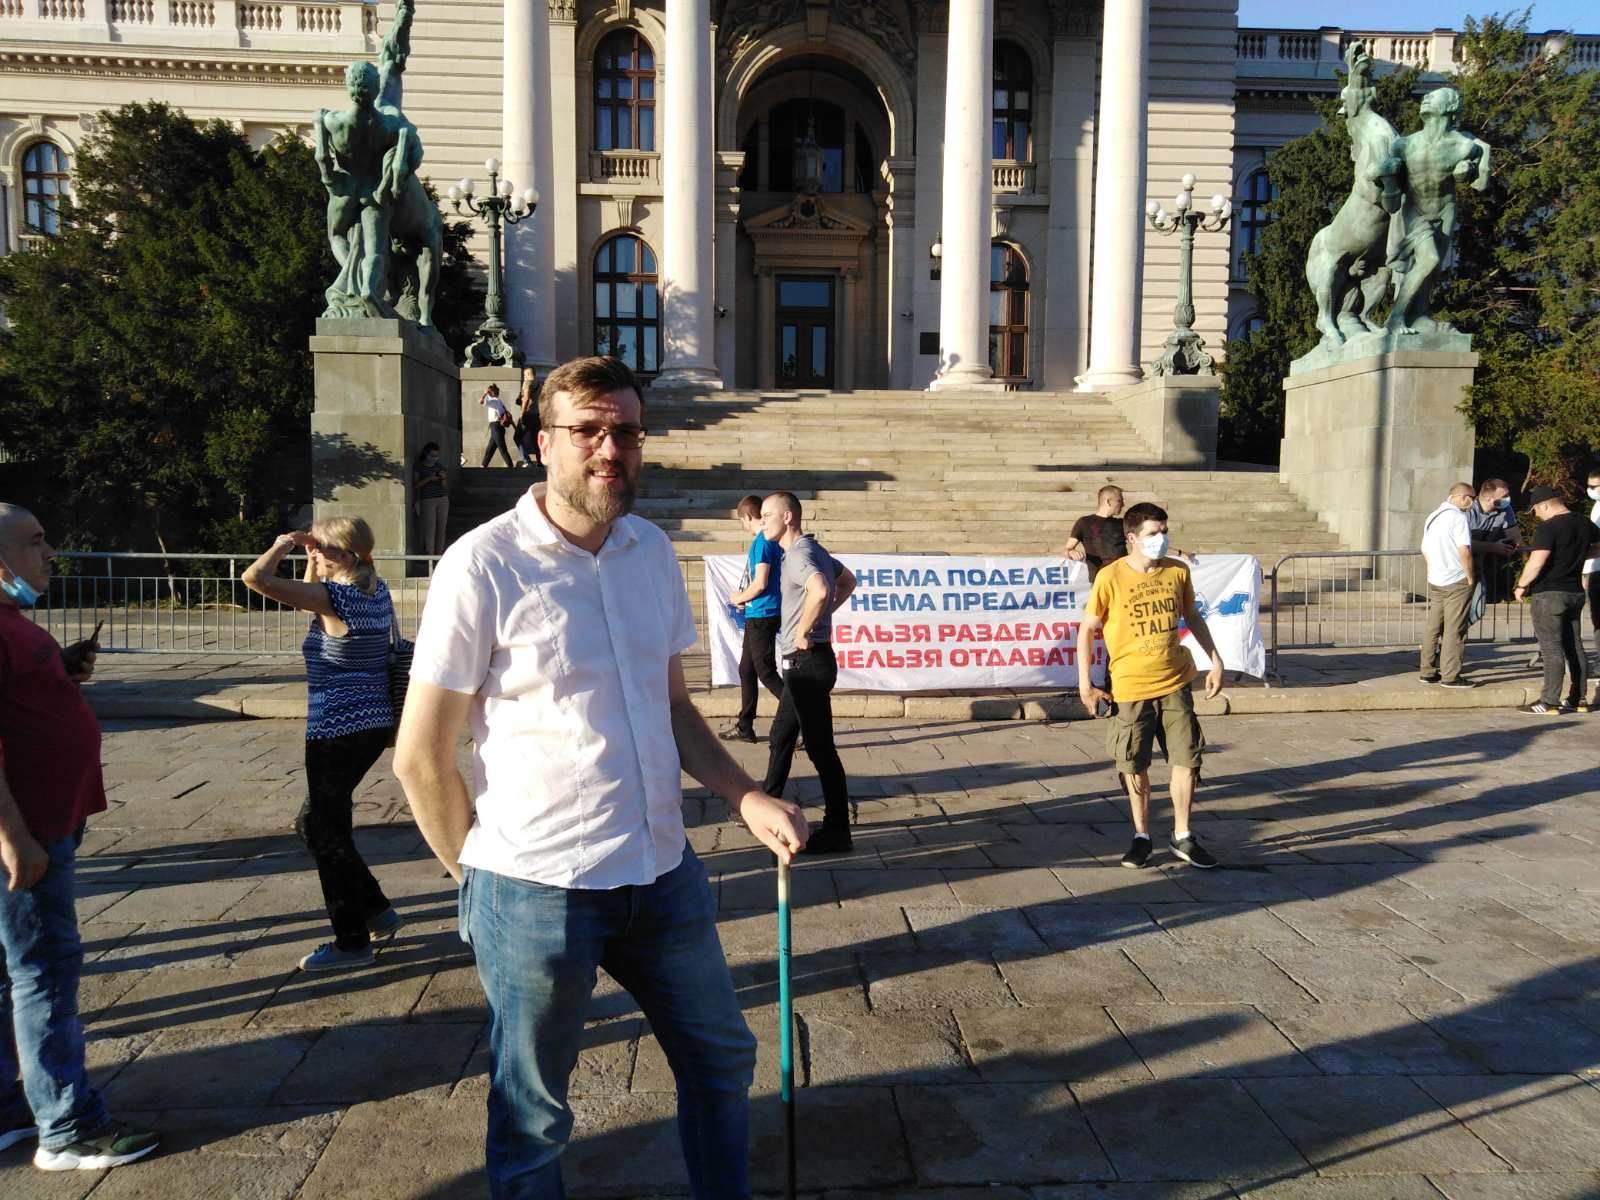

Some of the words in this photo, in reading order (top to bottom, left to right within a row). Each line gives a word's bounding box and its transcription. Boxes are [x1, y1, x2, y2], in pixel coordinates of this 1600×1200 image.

[856, 569, 941, 587] НЕМА
[949, 567, 1069, 587] ПОДЕЛЕ!
[851, 593, 936, 612] НЕМА
[943, 591, 1076, 611] ПРЕДАЈЕ!
[1133, 598, 1175, 618] STAND
[831, 624, 931, 644] ЕЛЬЗЯ
[1137, 616, 1178, 636] TALL
[950, 647, 1103, 668] ОТДАВАТ!
